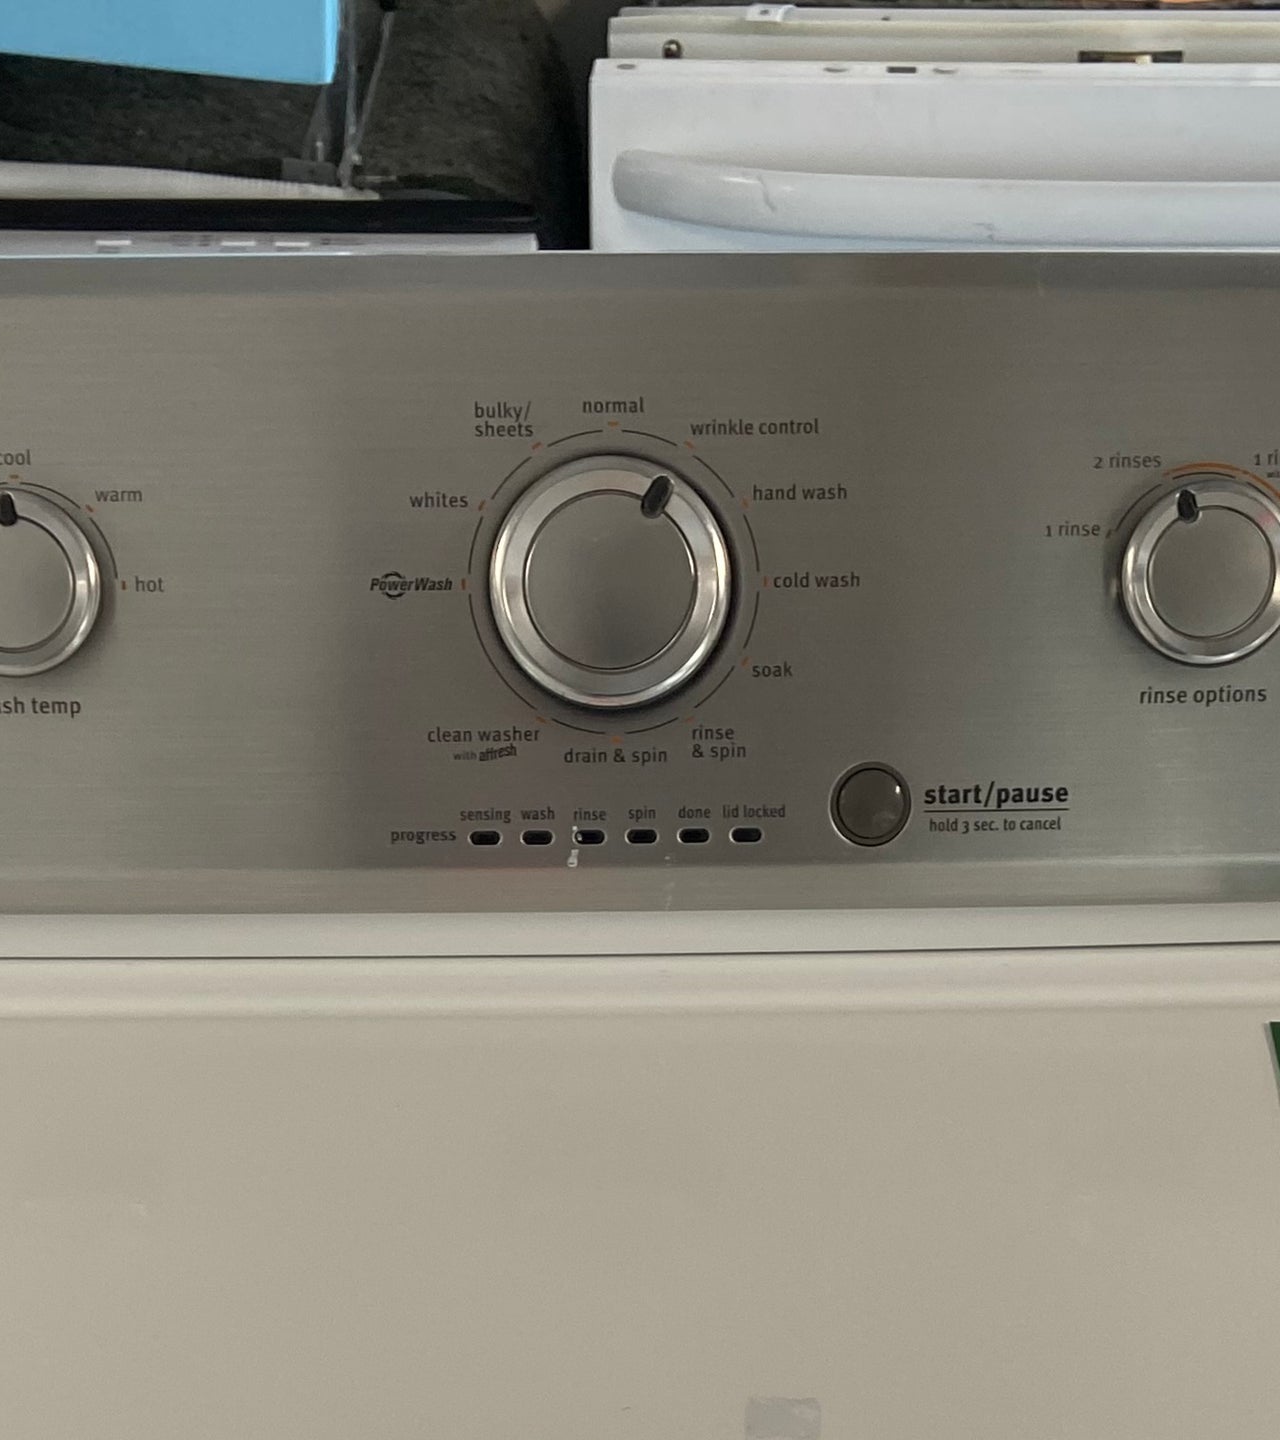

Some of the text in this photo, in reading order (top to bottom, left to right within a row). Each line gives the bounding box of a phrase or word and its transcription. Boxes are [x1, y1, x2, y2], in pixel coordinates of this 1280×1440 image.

[474, 401, 531, 423] bulky/
[582, 396, 644, 414] normal
[474, 419, 534, 439] sheets
[690, 417, 819, 436] wrinkle control
[1093, 451, 1162, 471] 2 rinses
[1255, 454, 1261, 466] 1
[95, 487, 143, 502] warm
[409, 491, 469, 509] whites
[752, 483, 848, 501] hand wash
[1045, 520, 1101, 538] 1 rinse
[135, 576, 164, 593] hot
[369, 576, 453, 592] PowerWash
[773, 571, 860, 589] cold wash
[751, 660, 793, 679] soak
[1139, 684, 1267, 707] rinse options
[29, 697, 81, 718] temp
[427, 725, 540, 744] clean washer
[692, 725, 734, 740] rinse
[453, 743, 517, 762] with affresh
[564, 749, 668, 767] drain & spin
[692, 743, 747, 761] & spin
[923, 781, 1069, 808] start/pause
[460, 808, 512, 823] sensing
[521, 806, 556, 821] wash
[573, 807, 606, 821] rinse
[629, 806, 657, 821] spin
[678, 804, 711, 819] done
[722, 803, 786, 819] lid locked
[929, 816, 1061, 835] hold 3 sec. to cancel
[390, 827, 457, 846] progress
